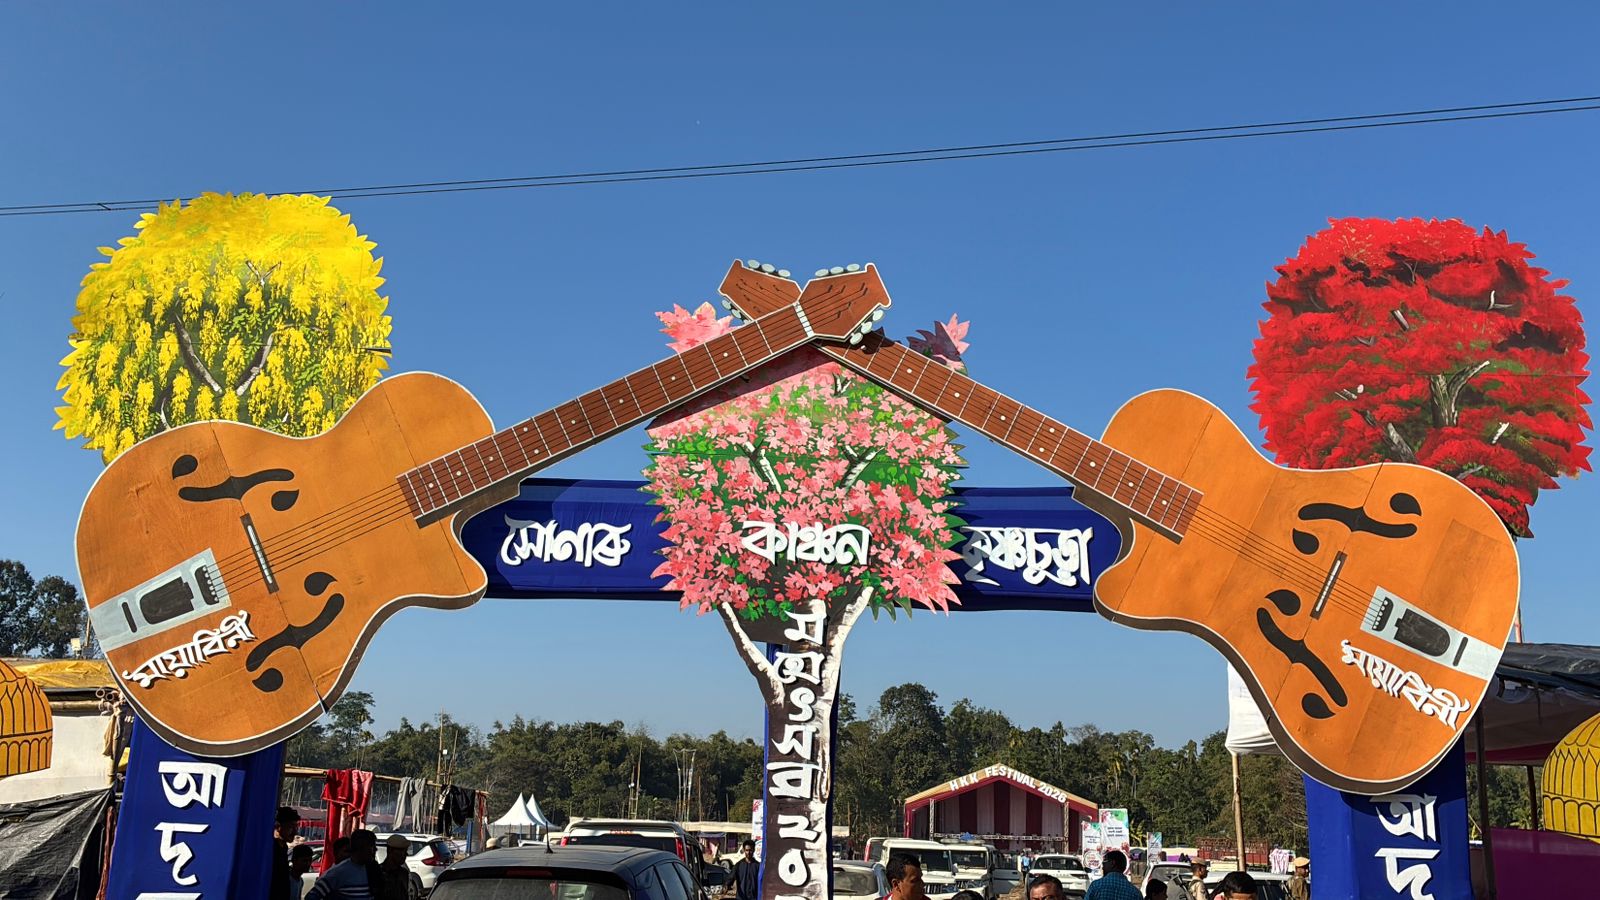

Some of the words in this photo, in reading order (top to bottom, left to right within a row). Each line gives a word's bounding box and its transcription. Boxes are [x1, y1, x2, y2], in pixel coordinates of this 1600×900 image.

[741, 520, 872, 566] কাঞ্চন
[121, 609, 256, 688] মায়াবিনী
[1341, 639, 1470, 731] মায়াবিনী
[948, 772, 980, 792] HKK
[984, 765, 1036, 789] FESTIVAL
[1037, 782, 1068, 803] 2026
[135, 761, 228, 900] আদ
[774, 814, 819, 900] ২০
